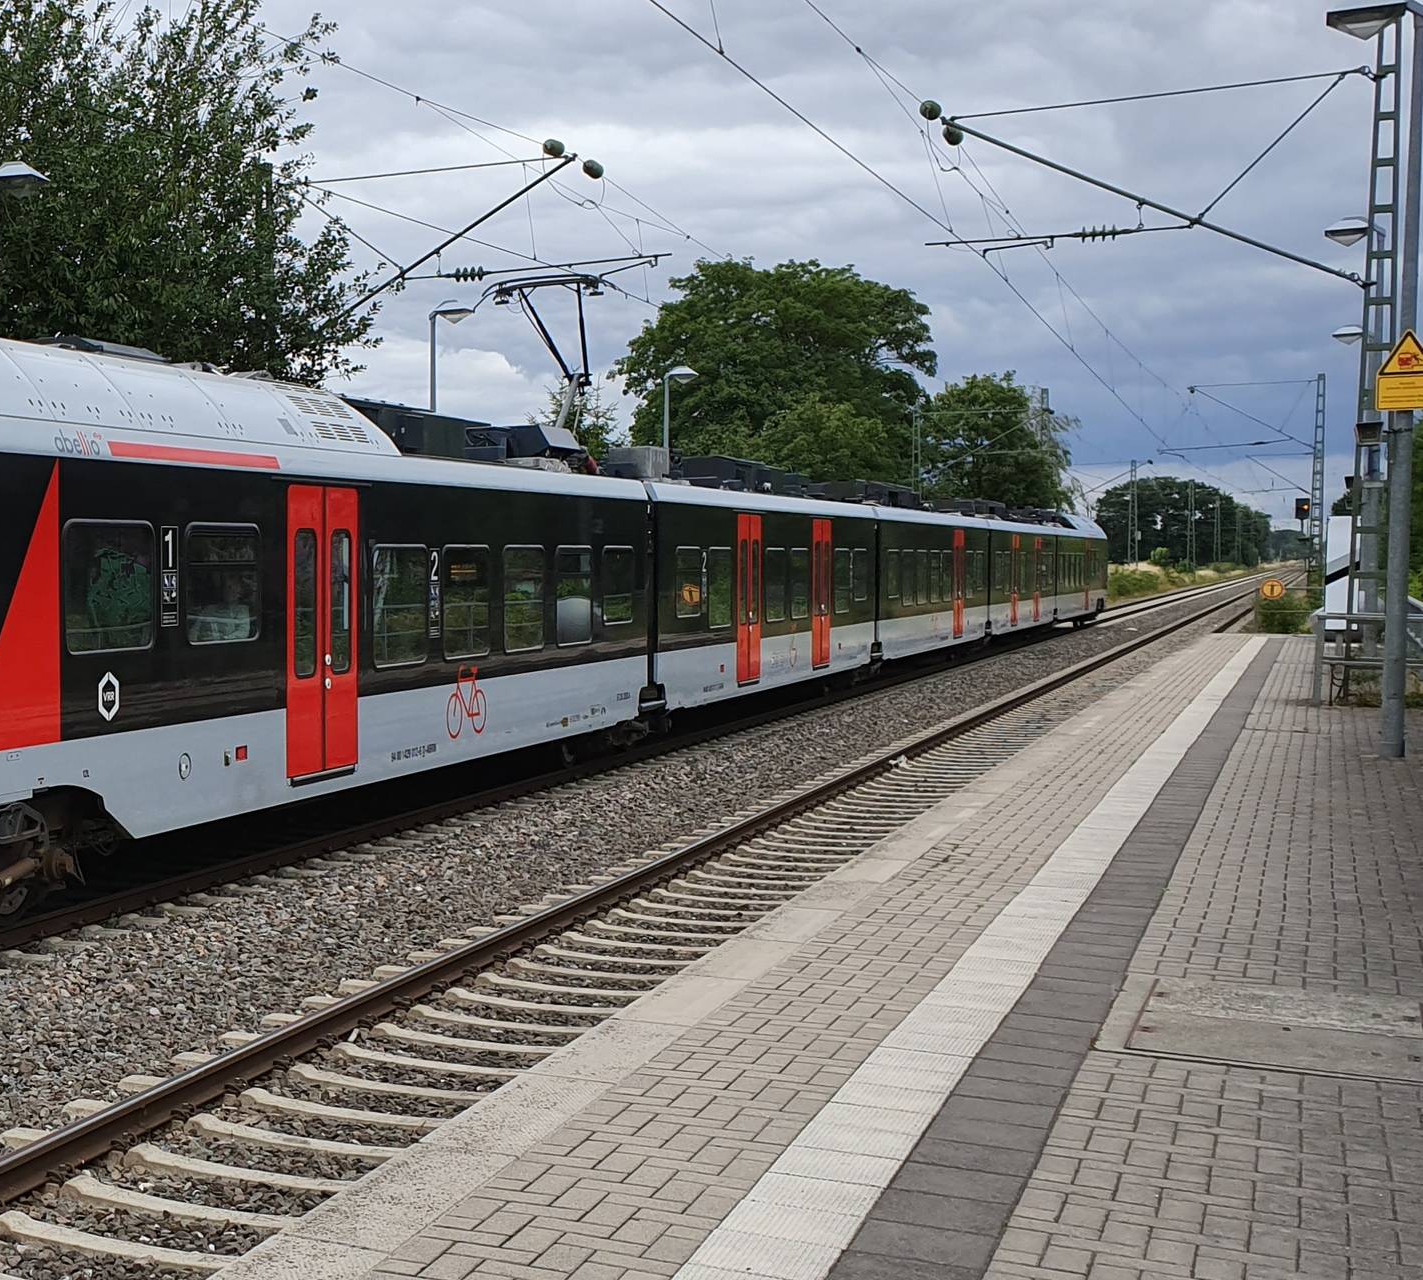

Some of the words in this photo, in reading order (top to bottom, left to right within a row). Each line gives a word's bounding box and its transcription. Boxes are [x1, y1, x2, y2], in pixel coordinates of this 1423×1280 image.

[54, 428, 100, 456] abellio
[164, 530, 173, 568] 1
[431, 551, 439, 580] 2
[103, 691, 115, 702] VRR
